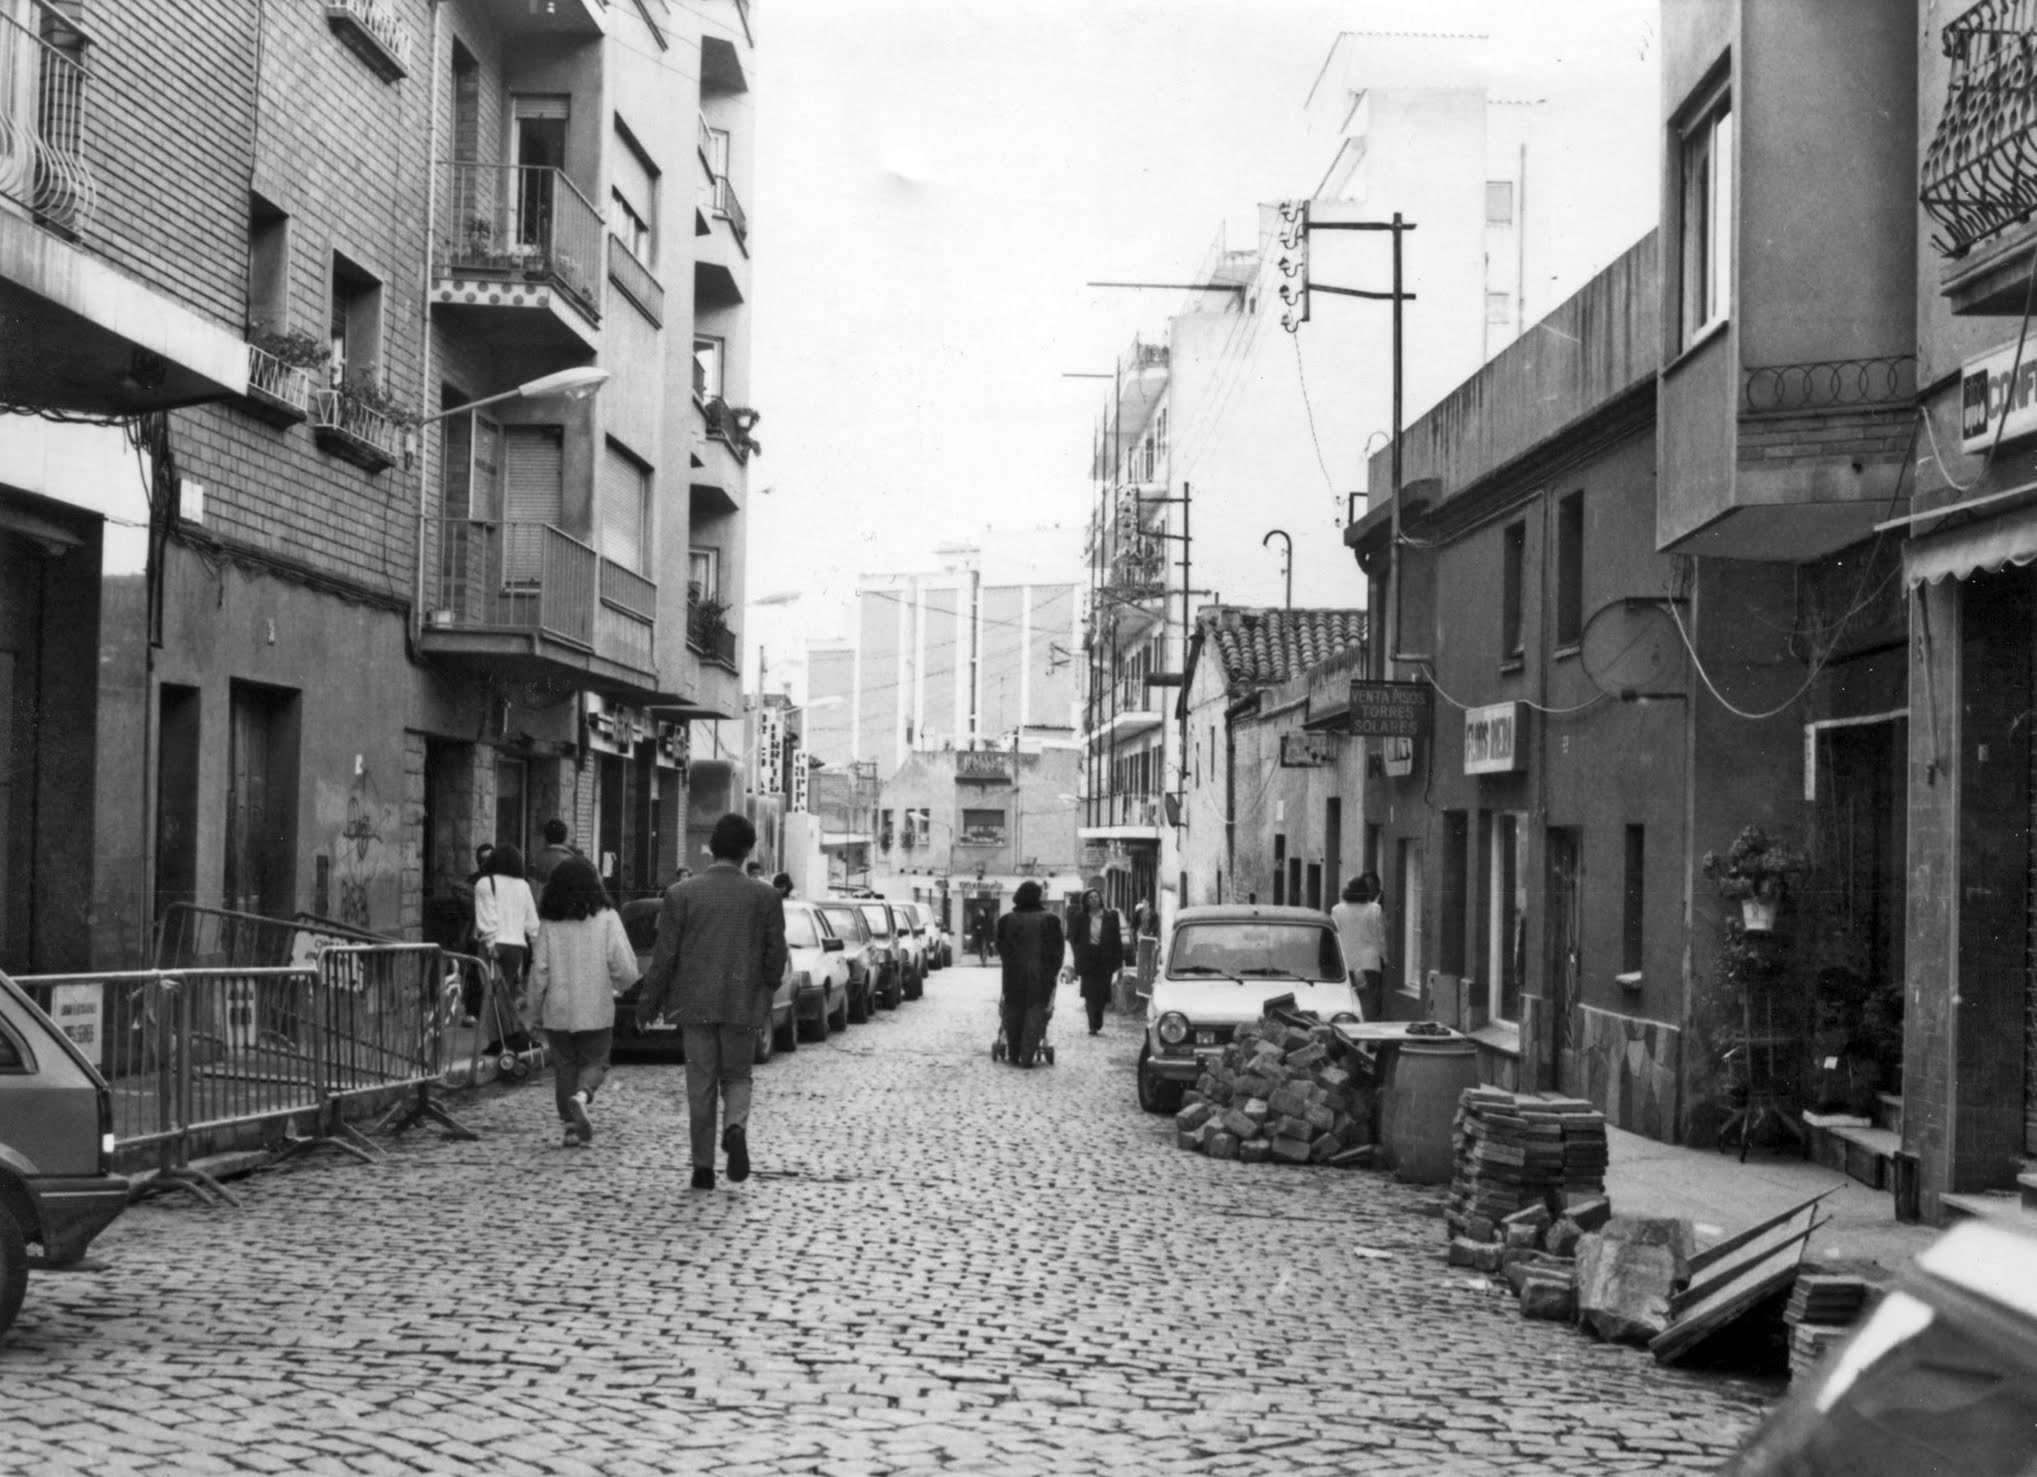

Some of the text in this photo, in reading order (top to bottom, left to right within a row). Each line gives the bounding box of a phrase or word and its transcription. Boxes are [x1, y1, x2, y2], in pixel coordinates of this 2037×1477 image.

[1351, 690, 1389, 704] VENTA
[1361, 704, 1414, 719] TORRES
[1354, 719, 1417, 735] SOLARES
